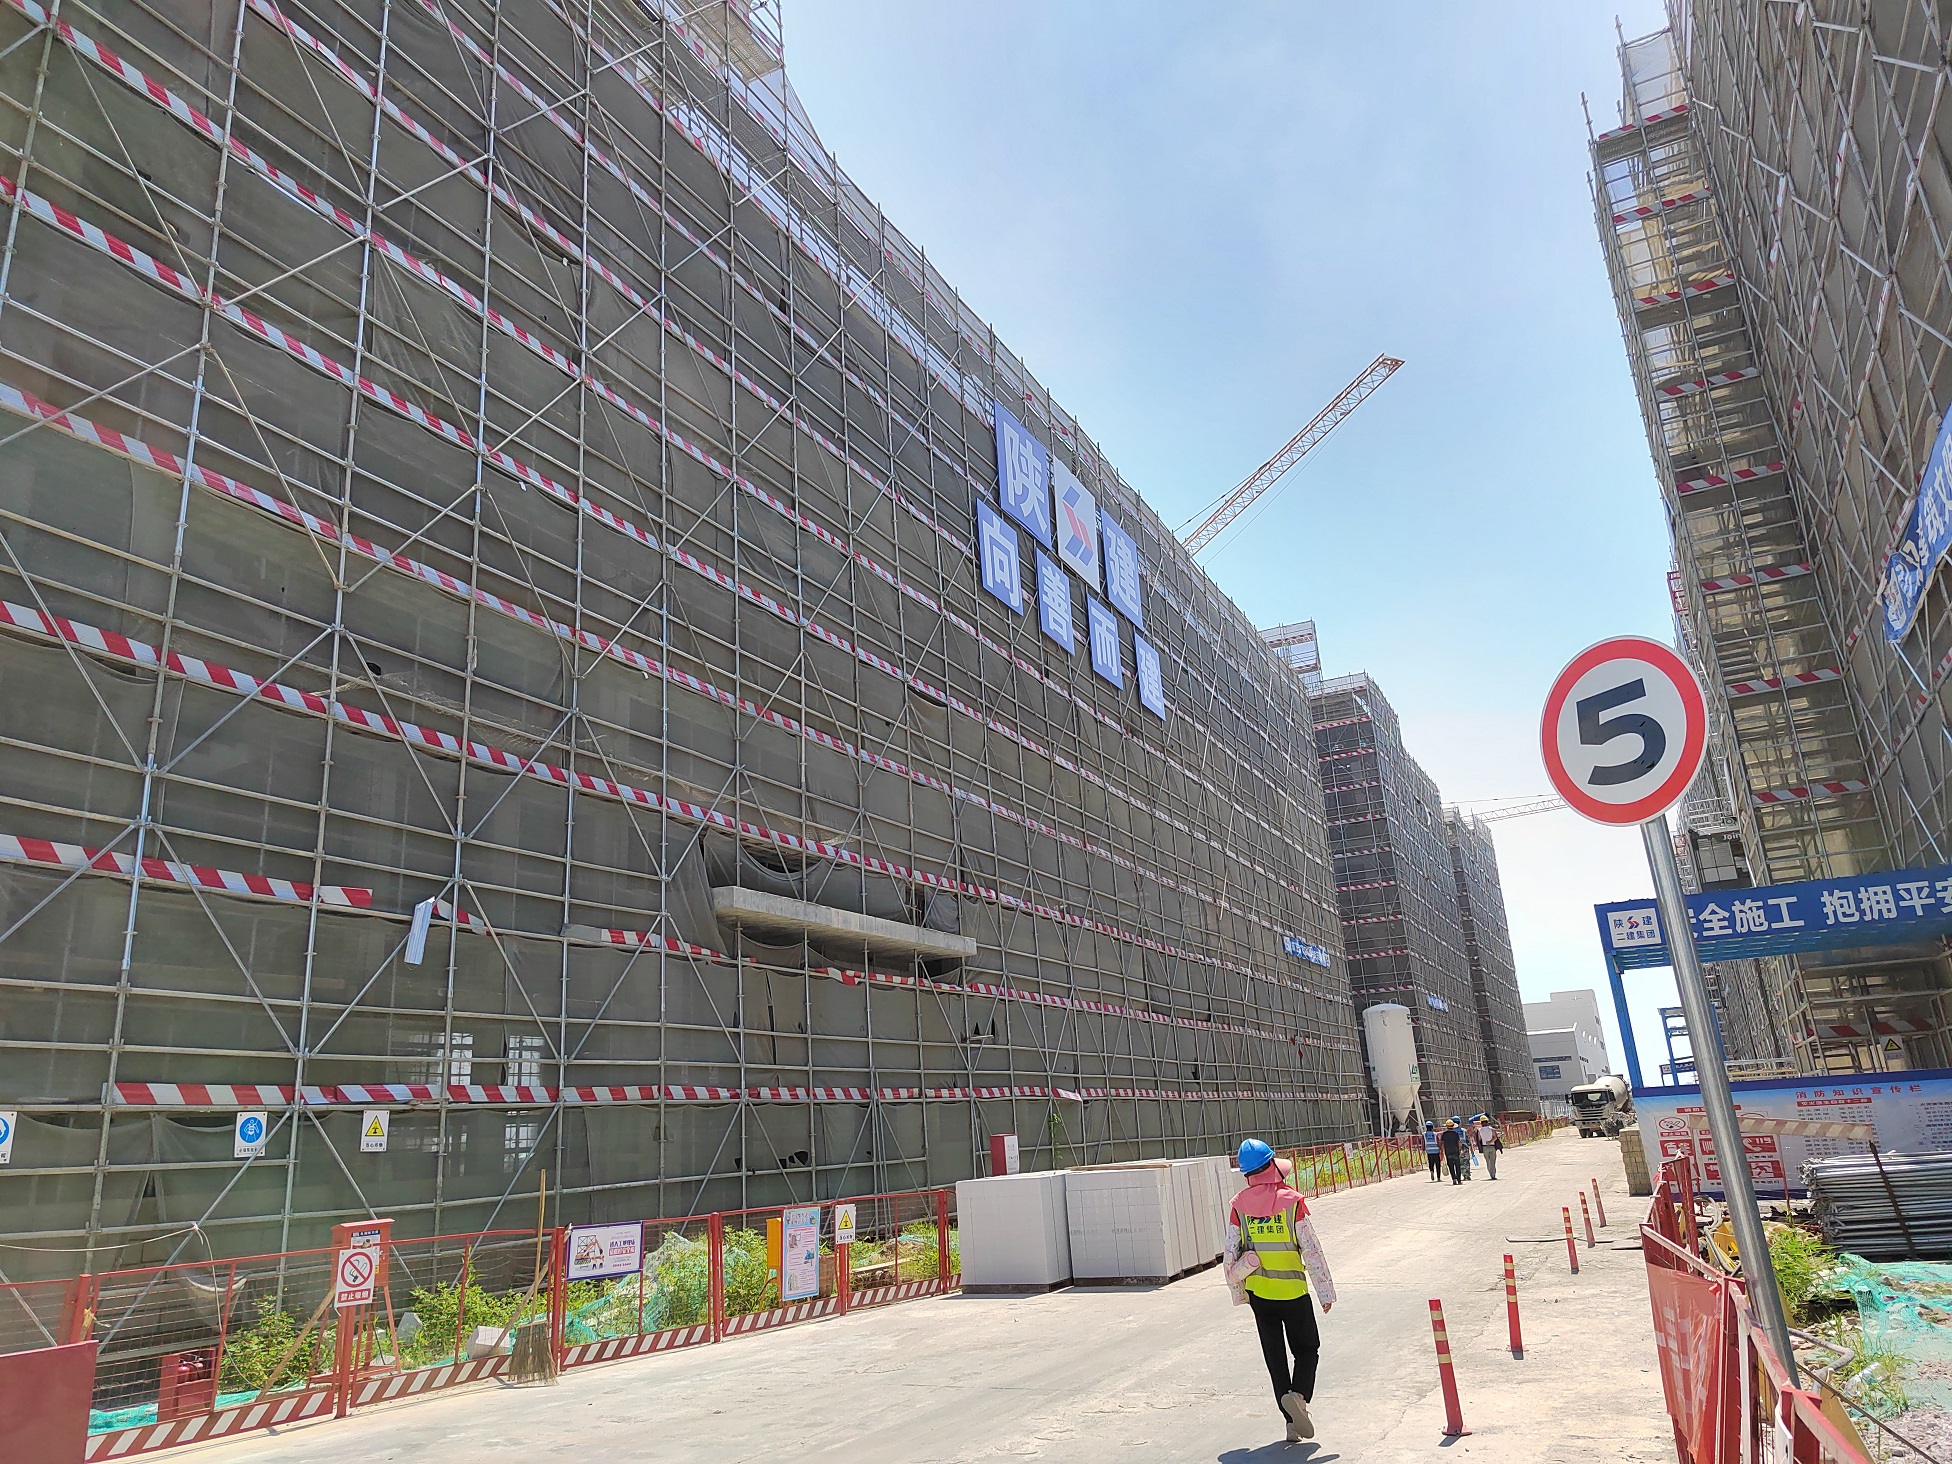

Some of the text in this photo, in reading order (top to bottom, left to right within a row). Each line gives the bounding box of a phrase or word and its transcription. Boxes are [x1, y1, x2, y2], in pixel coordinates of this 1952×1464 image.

[1004, 423, 1140, 617] 陕 建
[983, 515, 1164, 710] 向善而建
[1575, 677, 1667, 786] 5
[1612, 915, 1653, 929] 陕 建
[1616, 929, 1656, 941] 二建集团
[1795, 1084, 1922, 1099] 消防知识宣传栏
[1273, 1213, 1283, 1224] 建
[1249, 1225, 1284, 1235] 二建集团
